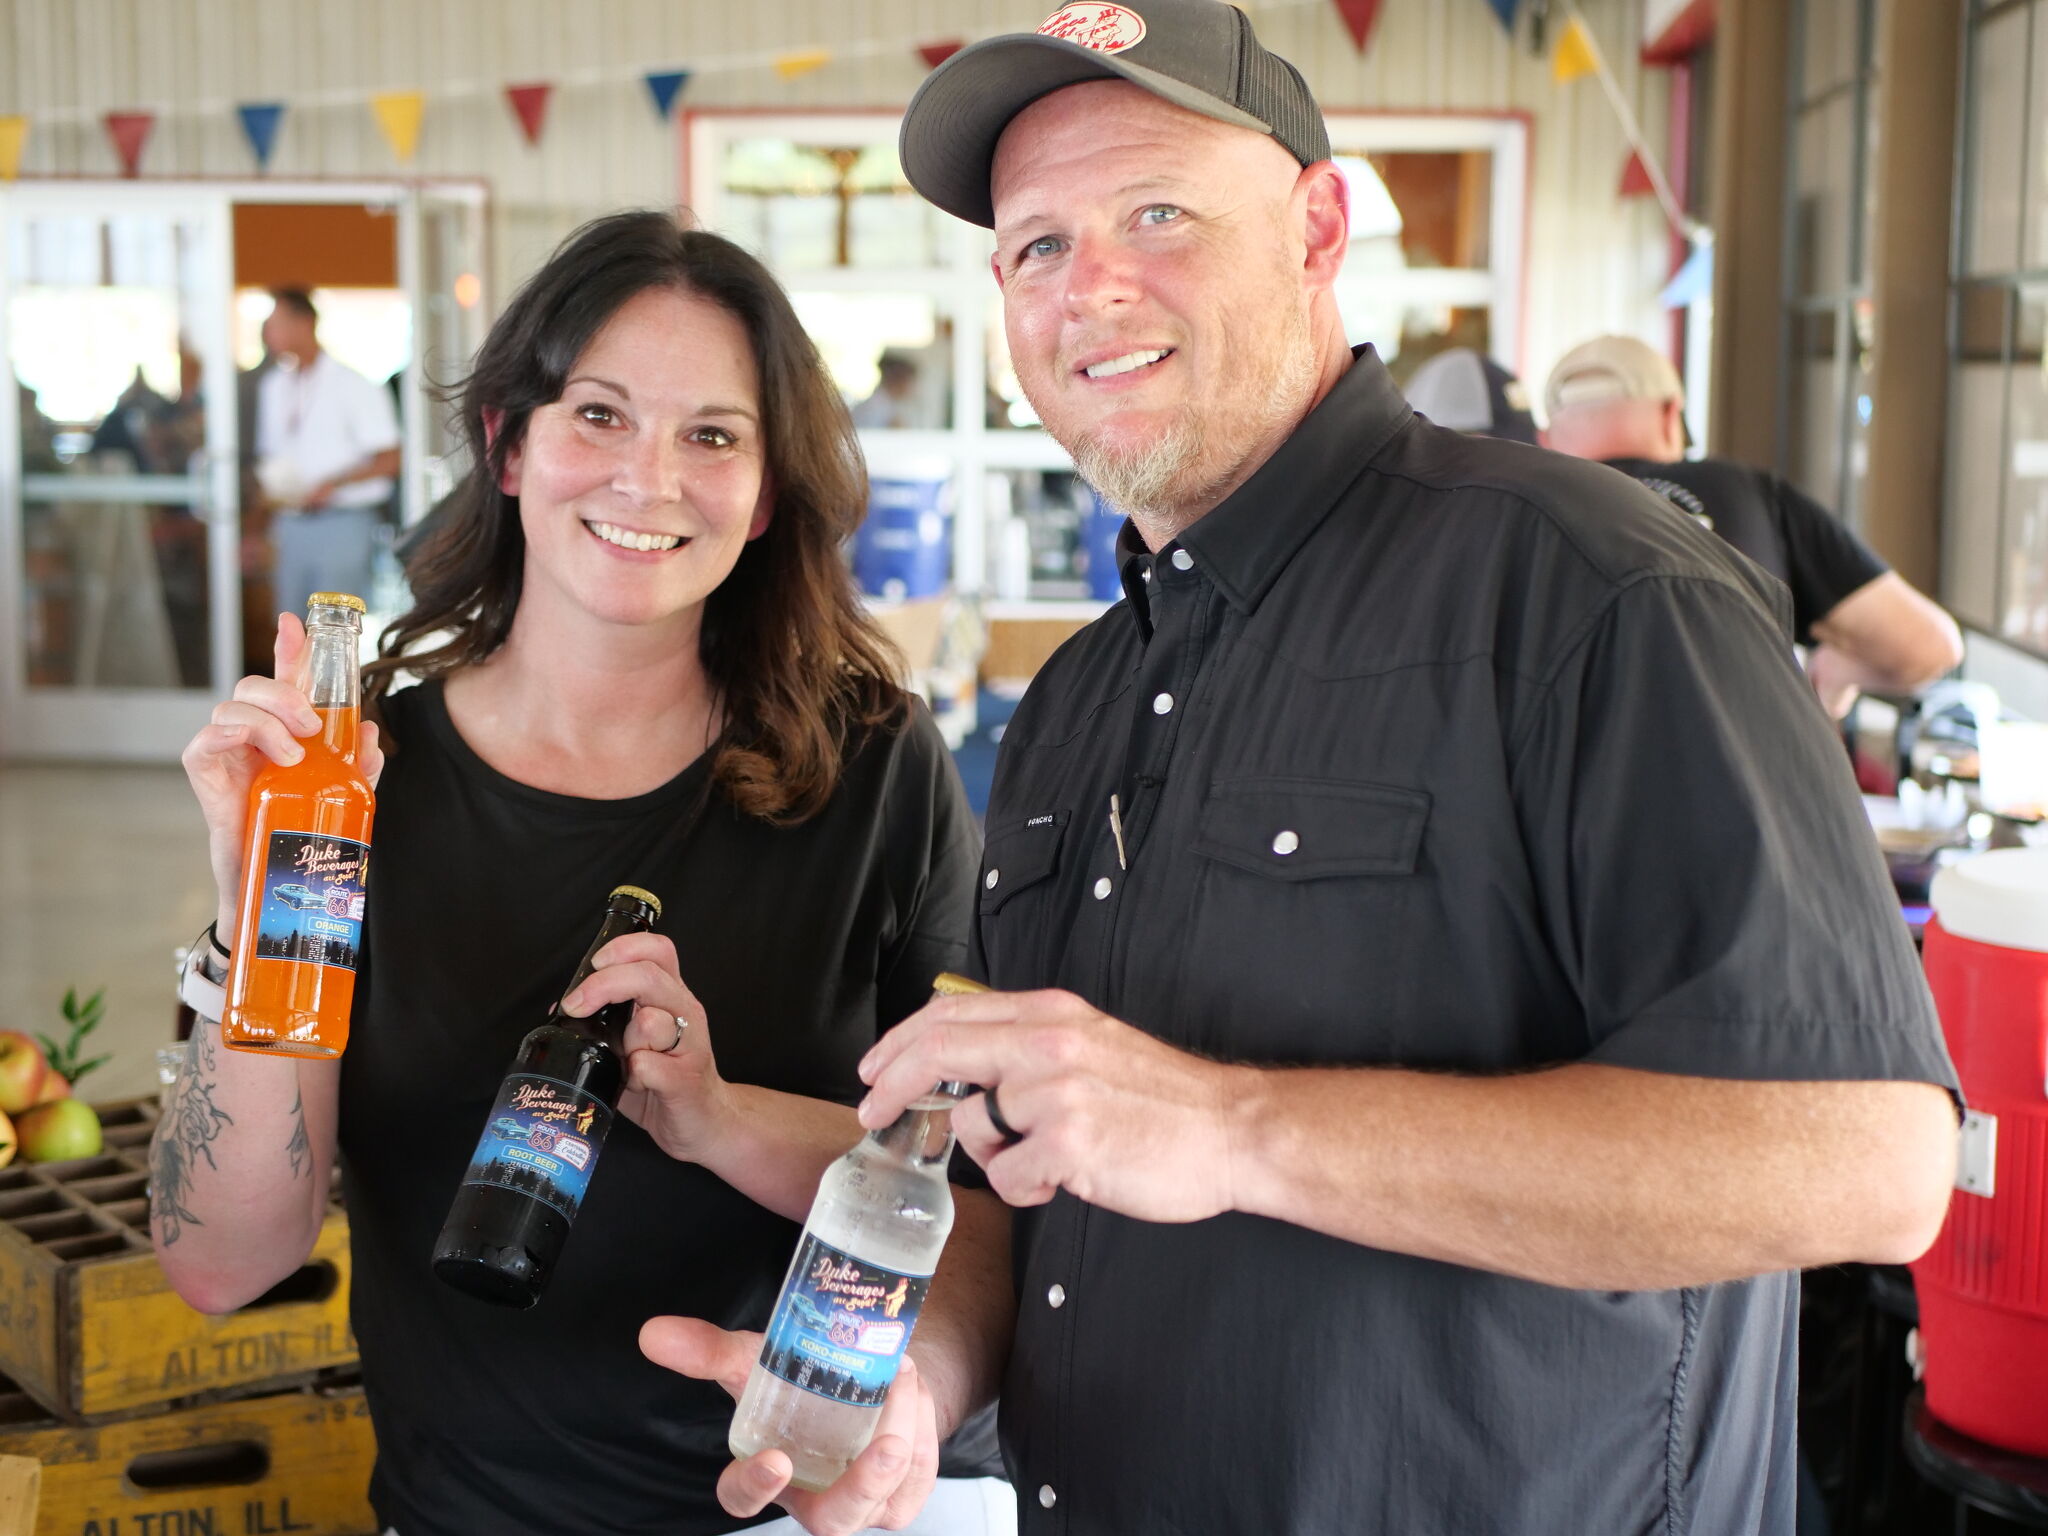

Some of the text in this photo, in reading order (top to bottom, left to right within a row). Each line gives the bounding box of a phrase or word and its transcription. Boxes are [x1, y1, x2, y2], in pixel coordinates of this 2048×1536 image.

[295, 843, 341, 866] Duke
[303, 860, 359, 876] Beverages
[330, 889, 348, 898] ROUTE
[329, 898, 348, 916] 66
[316, 920, 350, 934] ORANGE
[512, 1083, 556, 1102] Duke
[515, 1096, 577, 1113] Beverages
[536, 1124, 557, 1135] ROUTE
[531, 1132, 552, 1149] 66
[508, 1148, 534, 1161] ROOT
[534, 1156, 558, 1171] BEER
[812, 1257, 860, 1282] Duke
[816, 1276, 885, 1299] Beverages
[831, 1323, 856, 1345] 66
[801, 1338, 868, 1368] KOKO-KREME
